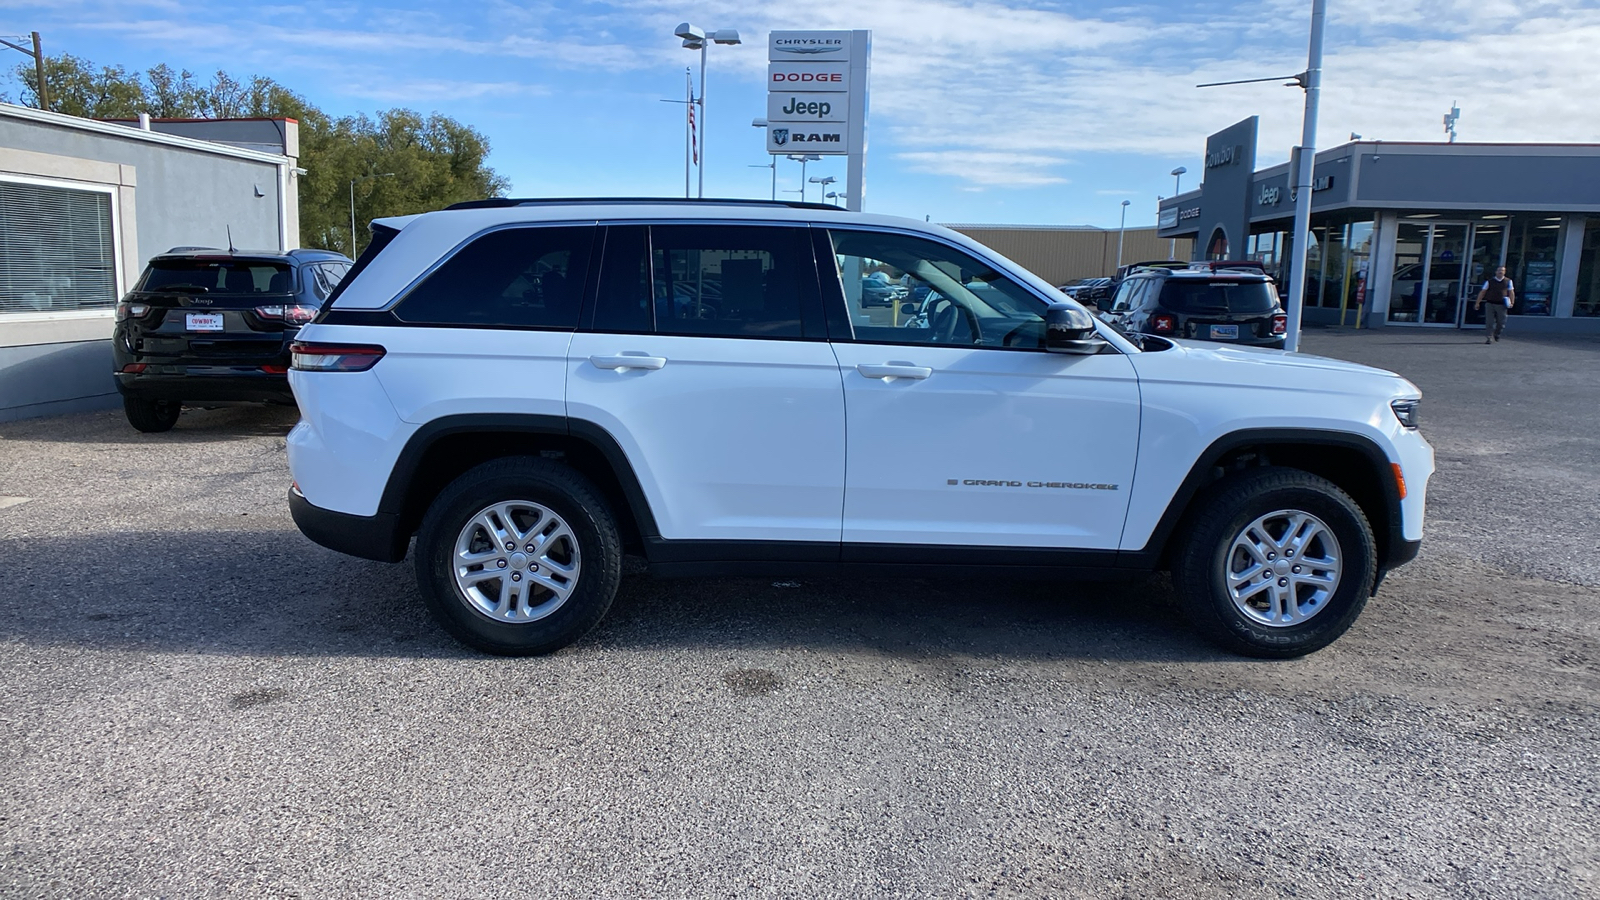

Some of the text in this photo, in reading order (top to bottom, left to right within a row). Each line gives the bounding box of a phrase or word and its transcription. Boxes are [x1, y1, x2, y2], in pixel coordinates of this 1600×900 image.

[772, 73, 842, 82] DODGE
[782, 97, 831, 118] Jeep
[792, 133, 840, 142] RAM
[1258, 184, 1280, 206] Jeep
[1180, 206, 1200, 220] DODGE
[963, 479, 1119, 490] GRAND CHEROKEE
